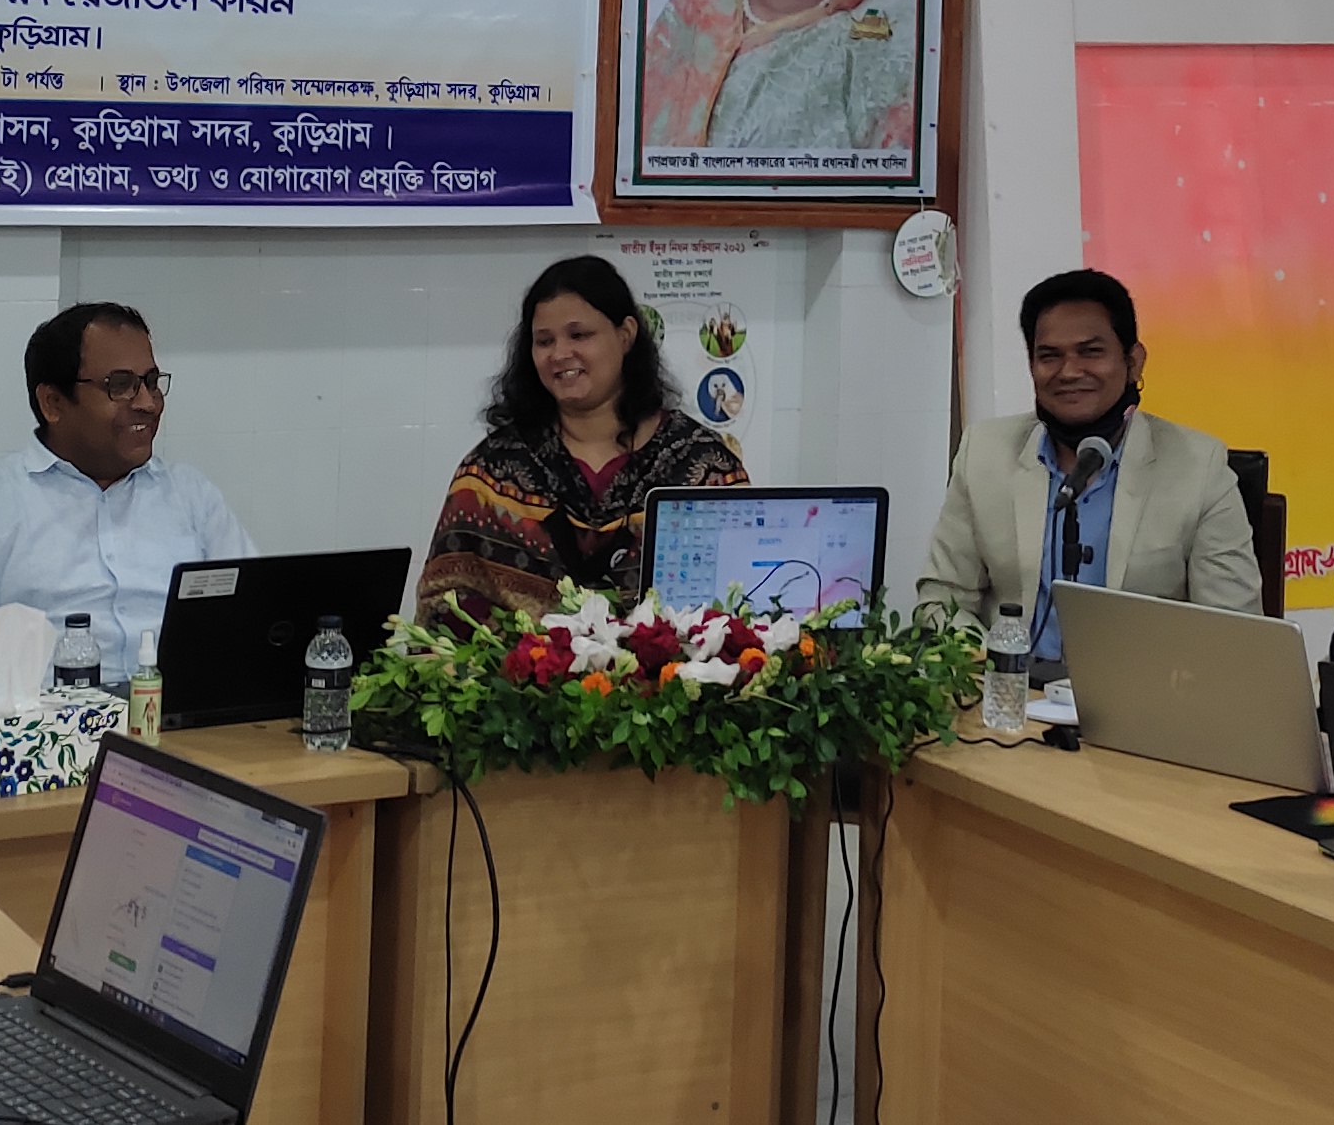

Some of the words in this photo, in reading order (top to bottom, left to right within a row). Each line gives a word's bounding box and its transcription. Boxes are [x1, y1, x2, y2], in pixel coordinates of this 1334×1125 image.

[0, 66, 18, 90] টা
[26, 65, 64, 91] পর্যন্ত
[116, 73, 146, 96] স্থান
[165, 70, 230, 95] উপজেলা
[237, 72, 286, 96] পরিষদ
[386, 76, 441, 103] কুড়িগ্রাম
[447, 83, 482, 104] সদর,
[70, 108, 181, 154] কুড়িগ্রাম
[189, 118, 260, 153] সদর,
[45, 163, 140, 197] প্রোগ্রাম,
[148, 163, 201, 192] তথ্য
[208, 166, 229, 190] ও
[240, 165, 351, 193] যোগাযোগ
[358, 161, 424, 199] প্রযুক্তি
[431, 161, 497, 193] বিভাগ
[702, 157, 743, 170] বাংলাদেশ
[746, 157, 785, 170] সরকারের
[861, 157, 879, 170] শেখ
[881, 154, 907, 170] হাসিনা
[723, 242, 746, 254] ২০২১
